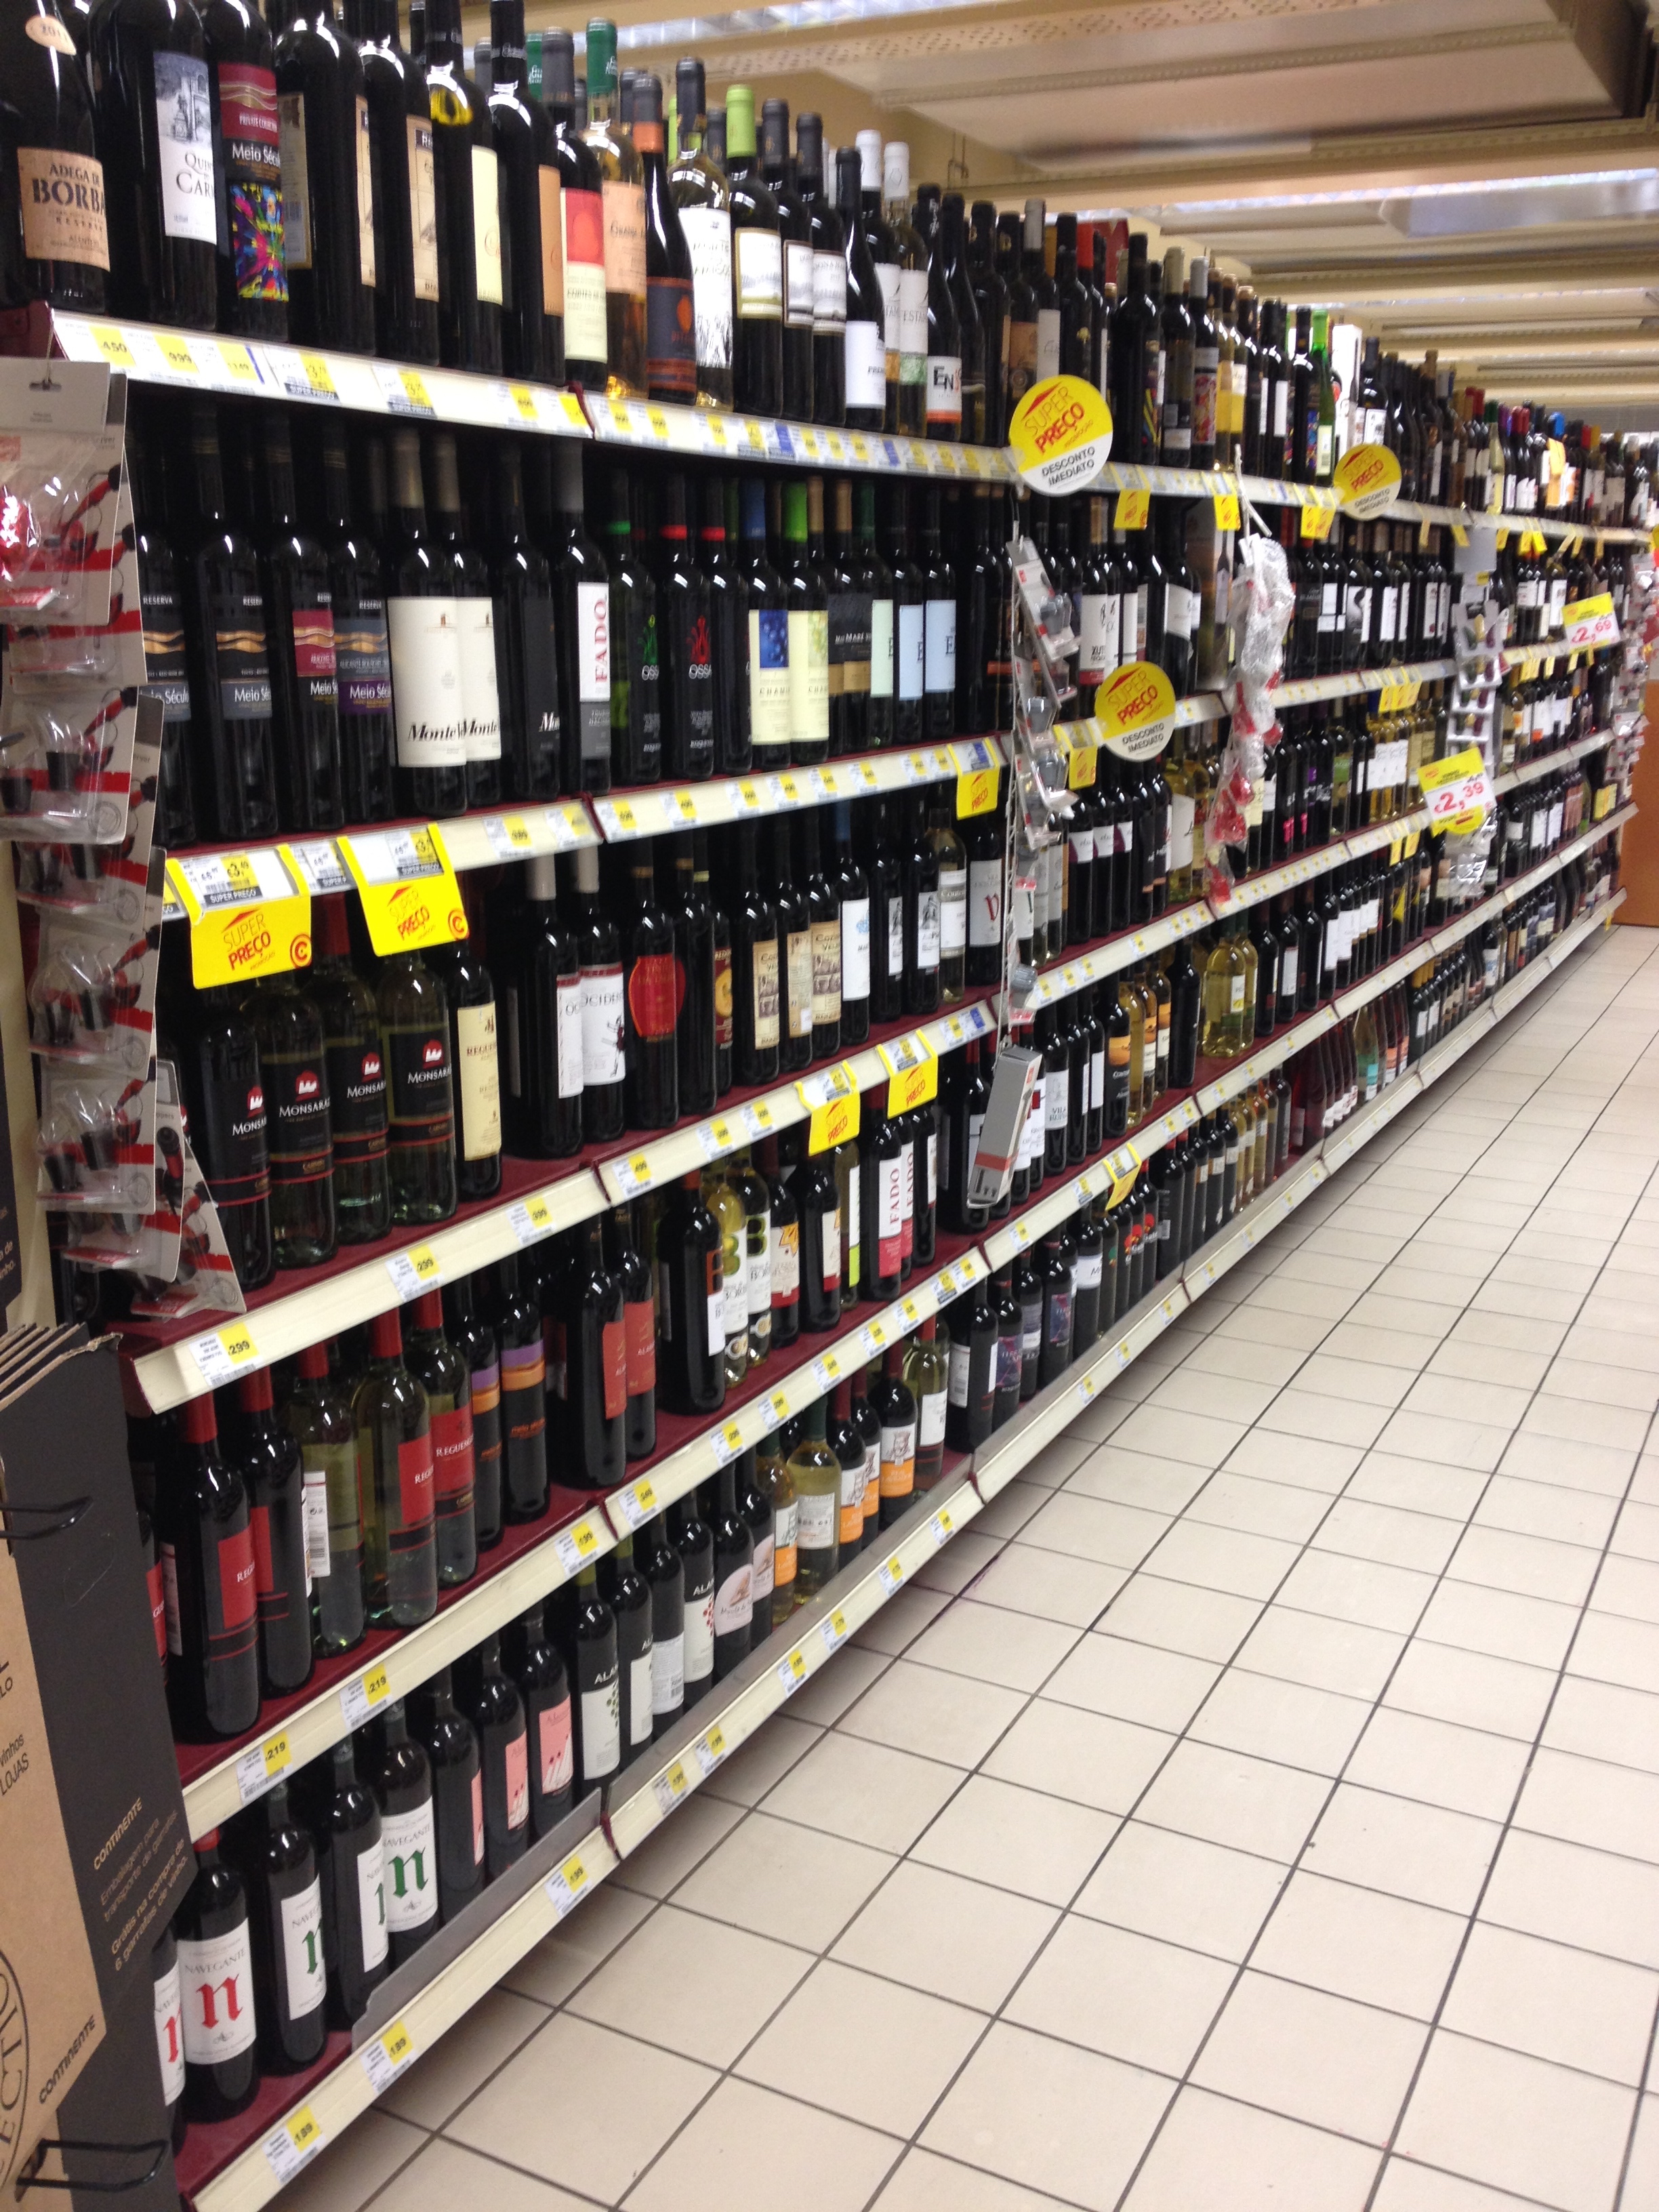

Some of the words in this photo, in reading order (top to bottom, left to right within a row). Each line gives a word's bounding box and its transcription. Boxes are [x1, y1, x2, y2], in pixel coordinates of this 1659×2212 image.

[232, 142, 262, 162] Meio
[49, 163, 89, 184] ADEGA
[1025, 386, 1073, 437] SUPER
[1035, 401, 1085, 455] PREÇO
[1042, 446, 1095, 476] DESCONTO
[1048, 458, 1095, 485] IMEDIATO
[142, 596, 173, 606] RESERVA
[594, 598, 608, 684] FADO
[234, 688, 260, 703] Meio
[310, 680, 331, 696] Meio
[350, 683, 375, 699] Meio
[1116, 684, 1158, 726] PREÇO
[1122, 722, 1164, 745] DESCONTO
[1128, 733, 1164, 753] IMEDIATO
[210, 893, 234, 903] SUPER
[223, 913, 267, 952] SUPER
[396, 905, 430, 941] PREÇO
[228, 930, 272, 971] PREÇO
[890, 1154, 900, 1223] FADO
[94, 1797, 143, 1870] CONTINENTE
[148, 1853, 176, 1900] compra
[122, 1905, 157, 1962] garrafas
[185, 1946, 247, 1975] NAVEGANTE
[39, 2013, 96, 2105] CONTINENTE
